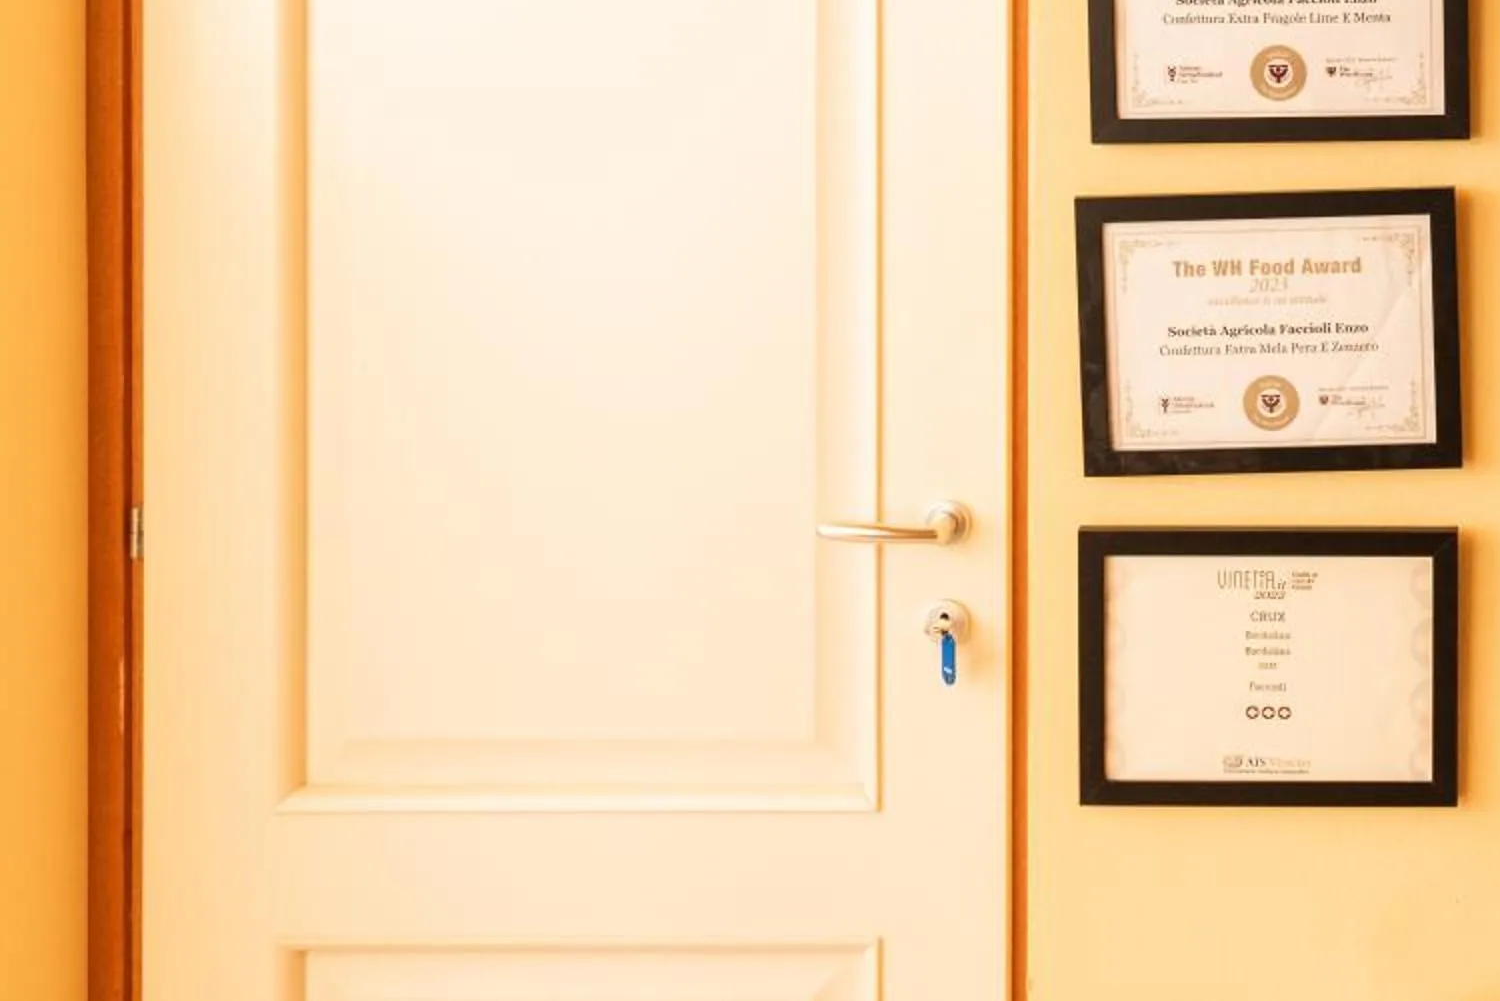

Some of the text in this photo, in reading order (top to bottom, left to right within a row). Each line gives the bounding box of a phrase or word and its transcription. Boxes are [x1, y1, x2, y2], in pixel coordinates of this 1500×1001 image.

[1163, 12, 1390, 26] Confettura Extra Fragole Lime E Menta
[1173, 257, 1362, 277] The WH Food Award
[1250, 278, 1289, 293] 2023
[1168, 323, 1368, 337] Società Agricola Faccioli Enzo
[1159, 342, 1378, 357] Confettura Extra Mela Pera E Zenzero
[1250, 610, 1286, 622] CRUX
